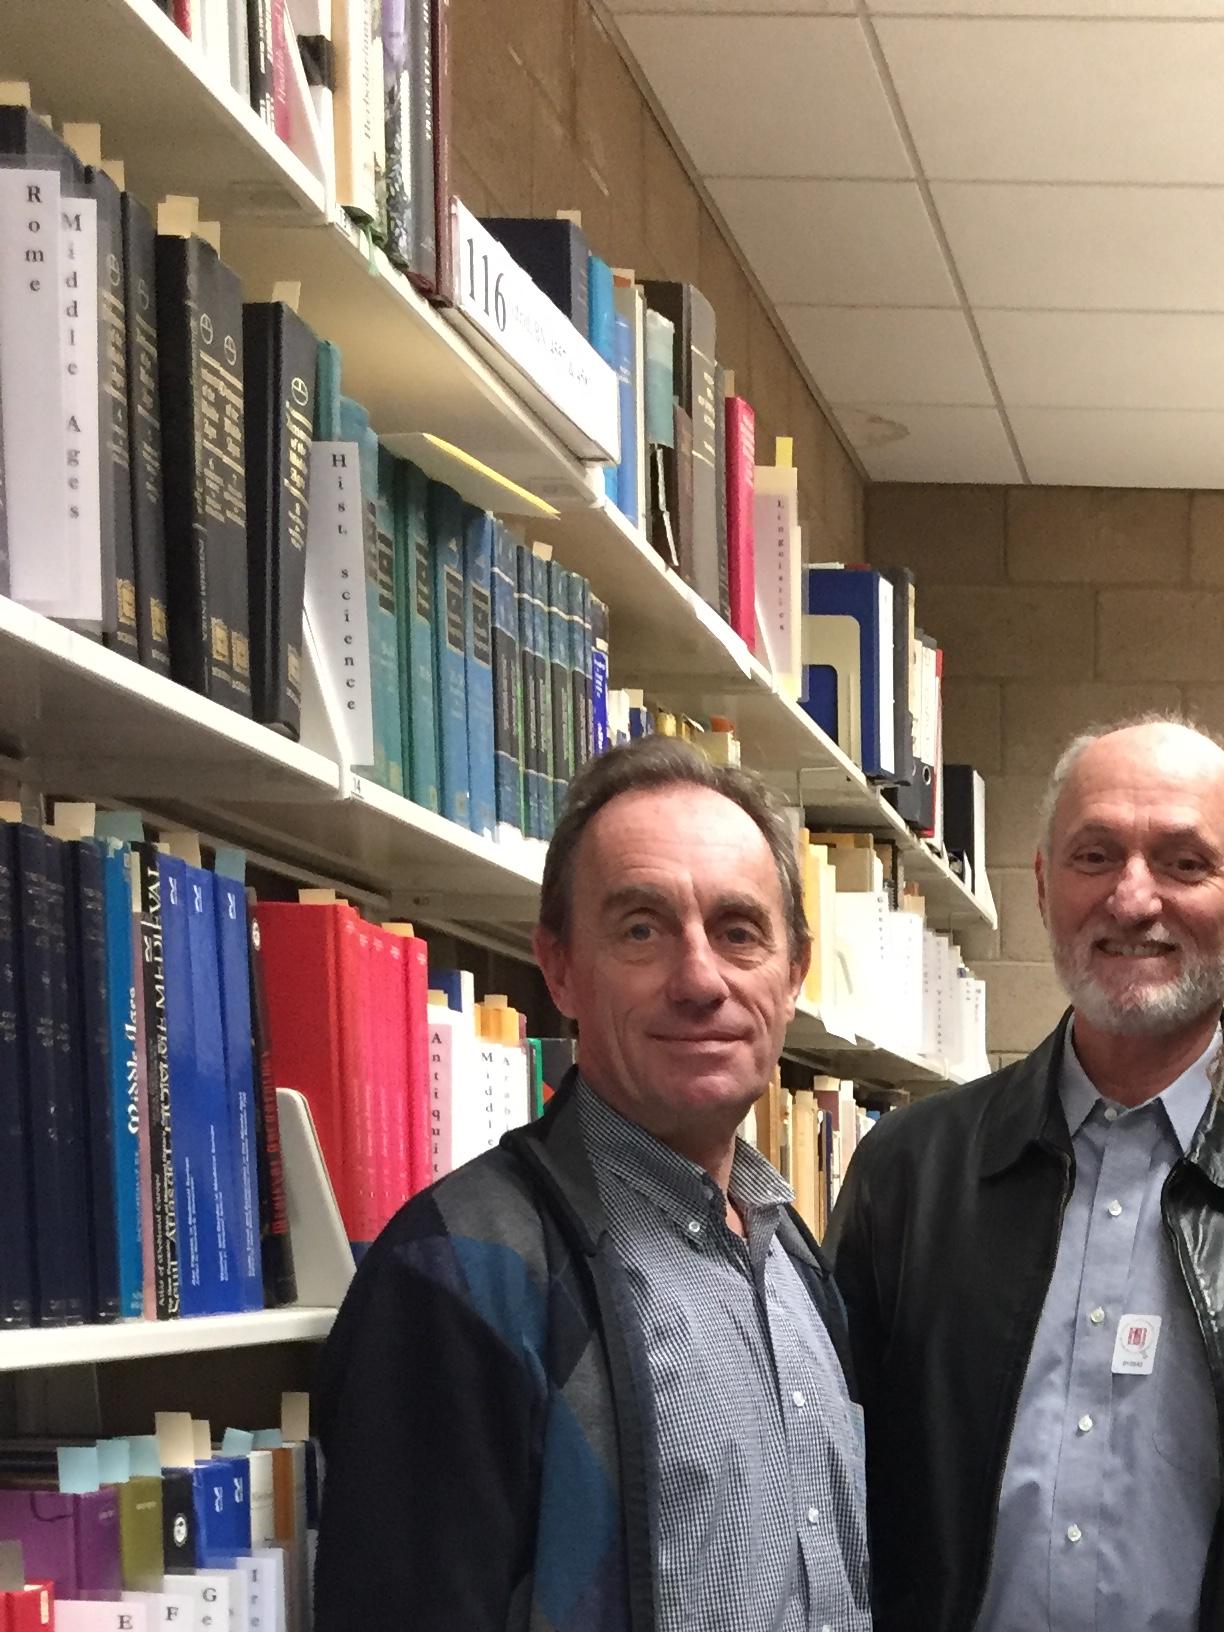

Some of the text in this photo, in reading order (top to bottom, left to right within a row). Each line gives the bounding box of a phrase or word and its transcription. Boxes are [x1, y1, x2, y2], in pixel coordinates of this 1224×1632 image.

[25, 185, 45, 295] Rome
[466, 238, 508, 333] 116
[60, 212, 83, 521] Middle Ages
[340, 567, 356, 711] science
[430, 1031, 443, 1174] Antiquit
[481, 1051, 494, 1147] Middle
